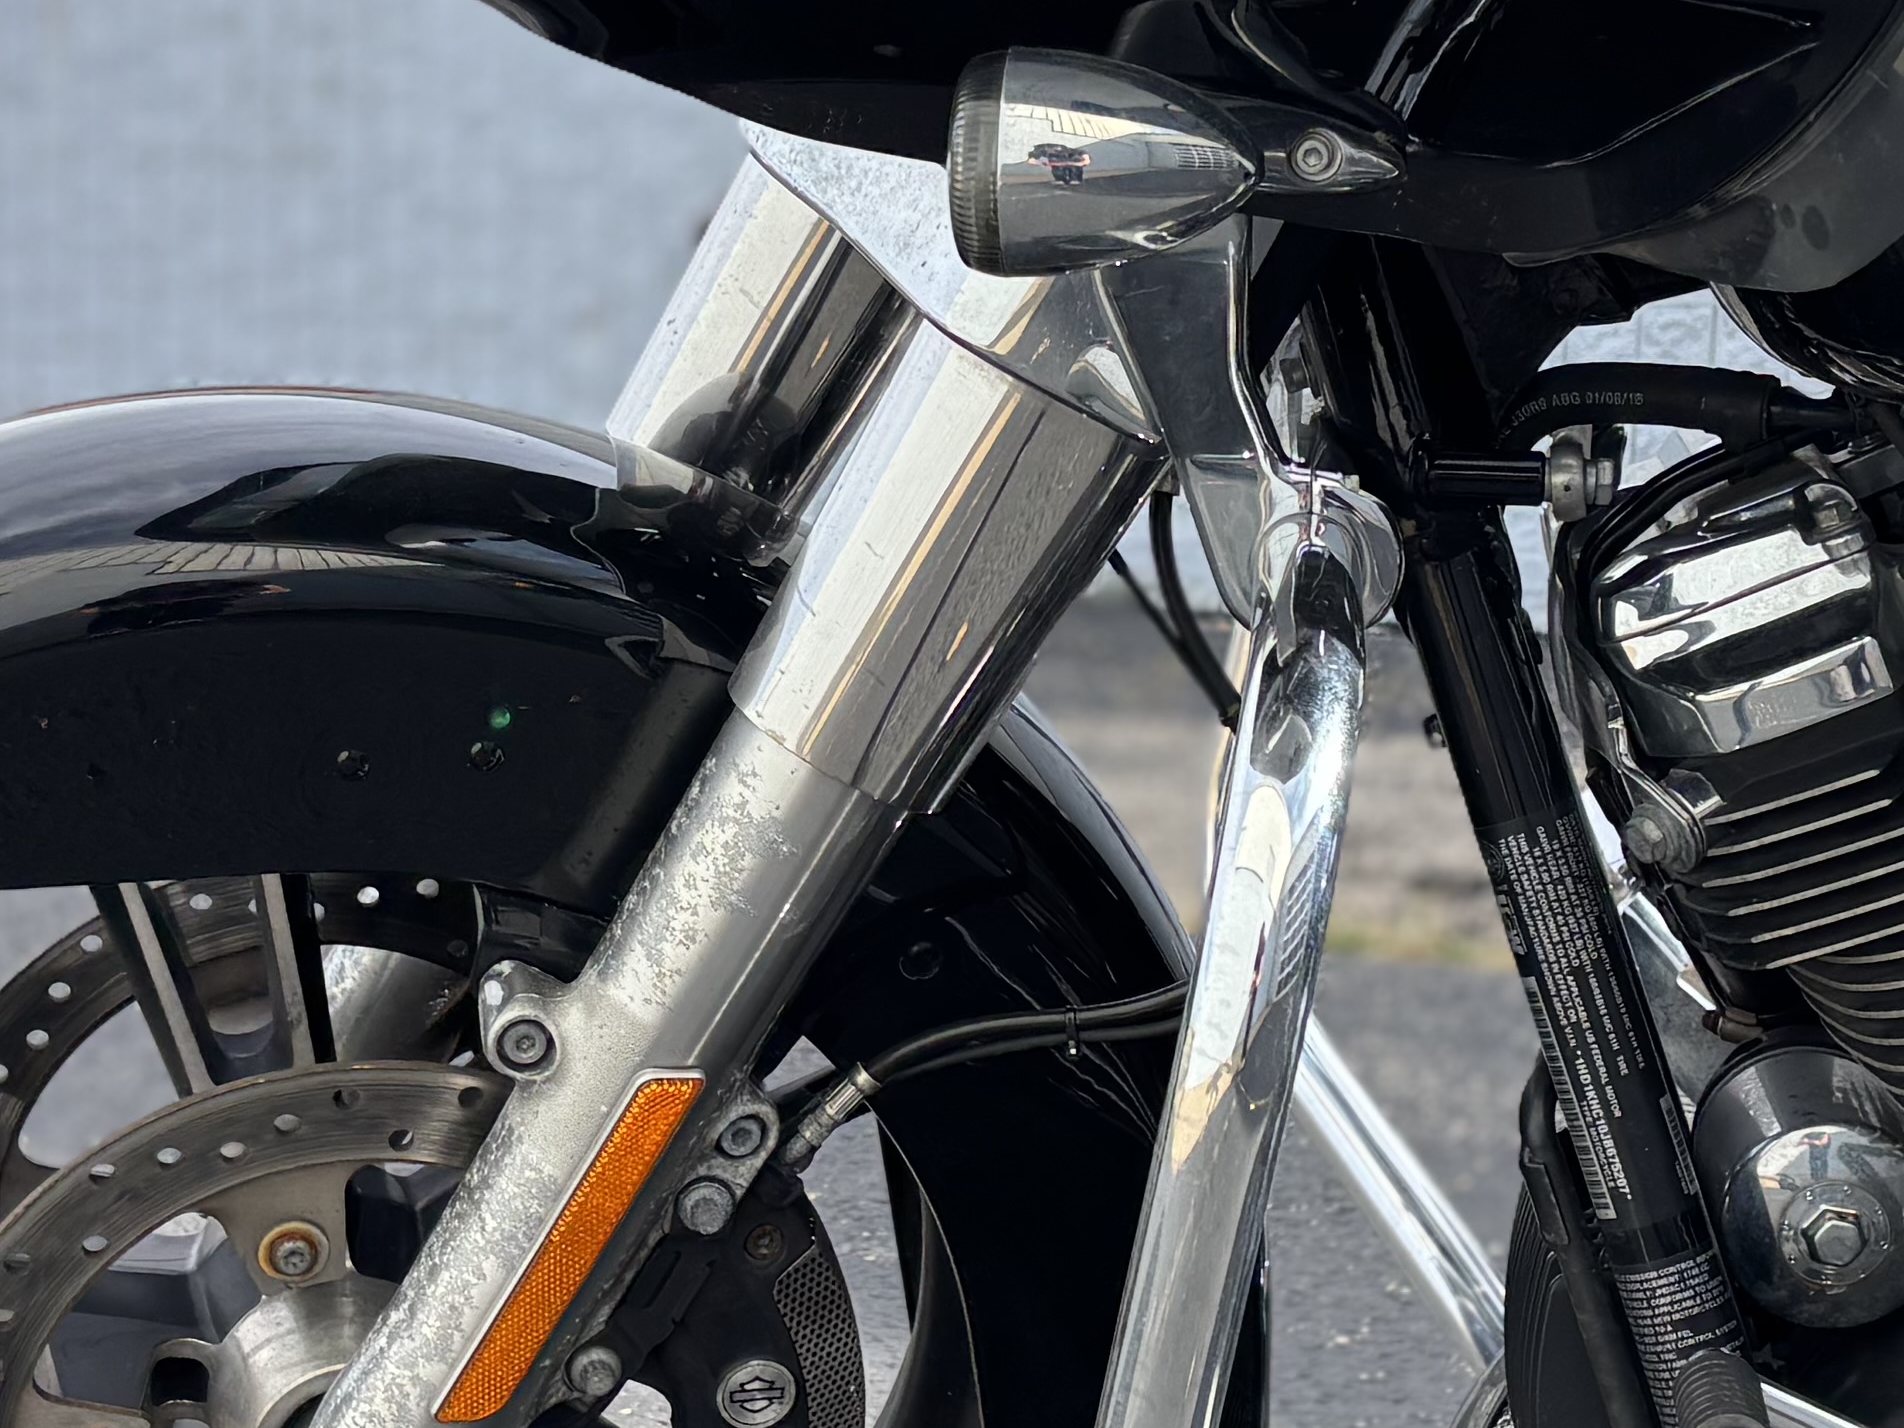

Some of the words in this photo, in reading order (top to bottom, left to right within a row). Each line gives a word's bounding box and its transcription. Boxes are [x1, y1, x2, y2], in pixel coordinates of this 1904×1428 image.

[1506, 835, 1525, 873] VEHICLE
[1516, 832, 1529, 853] THIS
[1523, 854, 1542, 891] VEHICLE
[1520, 873, 1537, 908] SAFETY
[1497, 838, 1509, 855] THE
[1504, 856, 1517, 880] DATE
[1512, 880, 1522, 894] OF
[1517, 894, 1545, 961] MANUFACTURE
[1540, 962, 1557, 995] SHOWN
[1551, 995, 1567, 1025] ABOVE
[1531, 908, 1556, 962] STANDARDS
[1536, 892, 1560, 943] CONFORMS
[1551, 901, 1561, 913] AT
[1564, 940, 1580, 967] COLD
[1555, 943, 1564, 956] TO
[1583, 933, 1597, 959] COLD
[1550, 962, 1560, 973] IN
[1559, 957, 1570, 974] ALL
[1554, 973, 1572, 1007] EFFECT
[1565, 974, 1590, 1028] APPLICABLE
[1566, 1008, 1577, 1022] ON
[1584, 1029, 1595, 1043] US
[1589, 1043, 1609, 1084] FEDERAL
[1604, 1085, 1621, 1117] MOTOR
[1588, 1126, 1615, 1187] MOTORCYCLE
